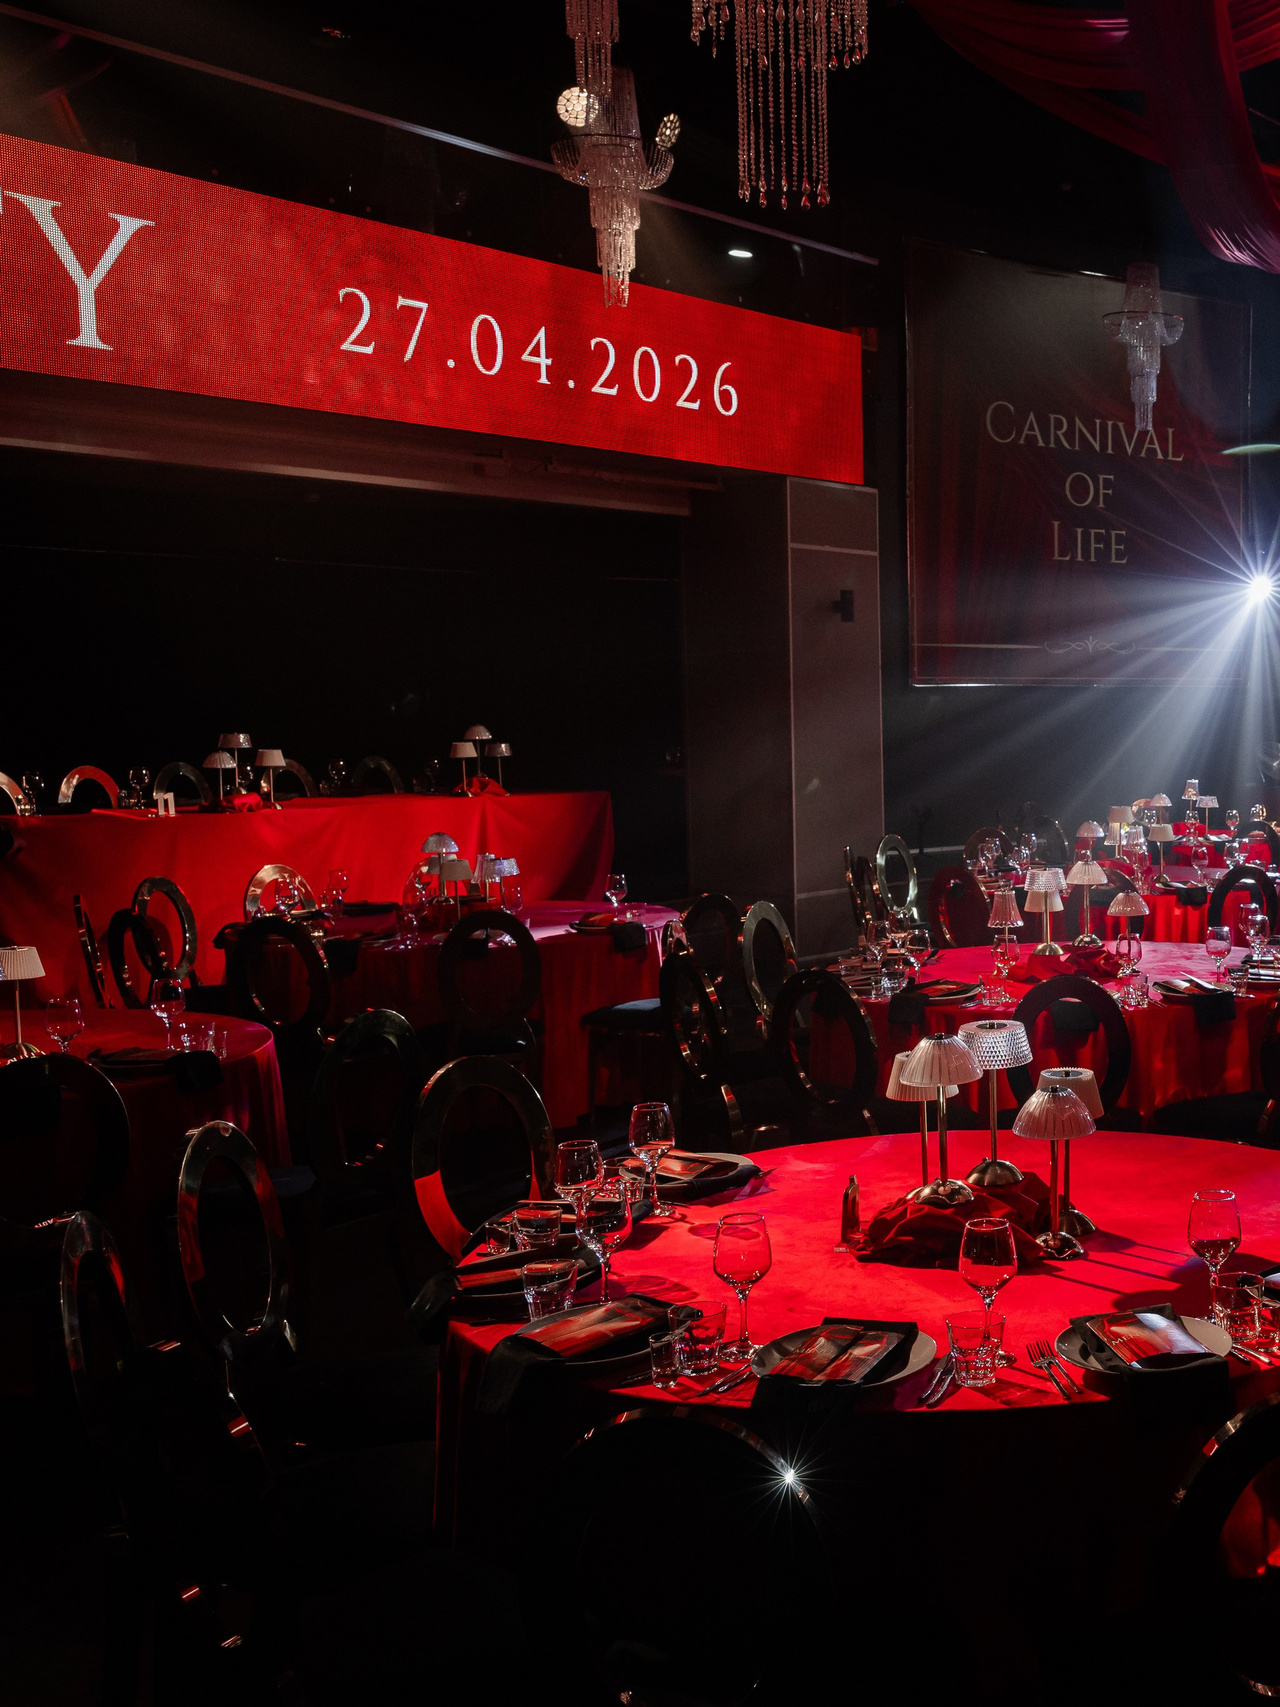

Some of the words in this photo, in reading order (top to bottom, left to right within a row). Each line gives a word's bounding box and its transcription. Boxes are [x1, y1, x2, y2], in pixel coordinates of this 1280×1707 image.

[0, 187, 156, 351] Y
[338, 287, 738, 416] 27.04.2026
[985, 401, 1184, 462] CARNIVAL
[1065, 472, 1114, 508] OF
[1052, 520, 1128, 564] LIFE
